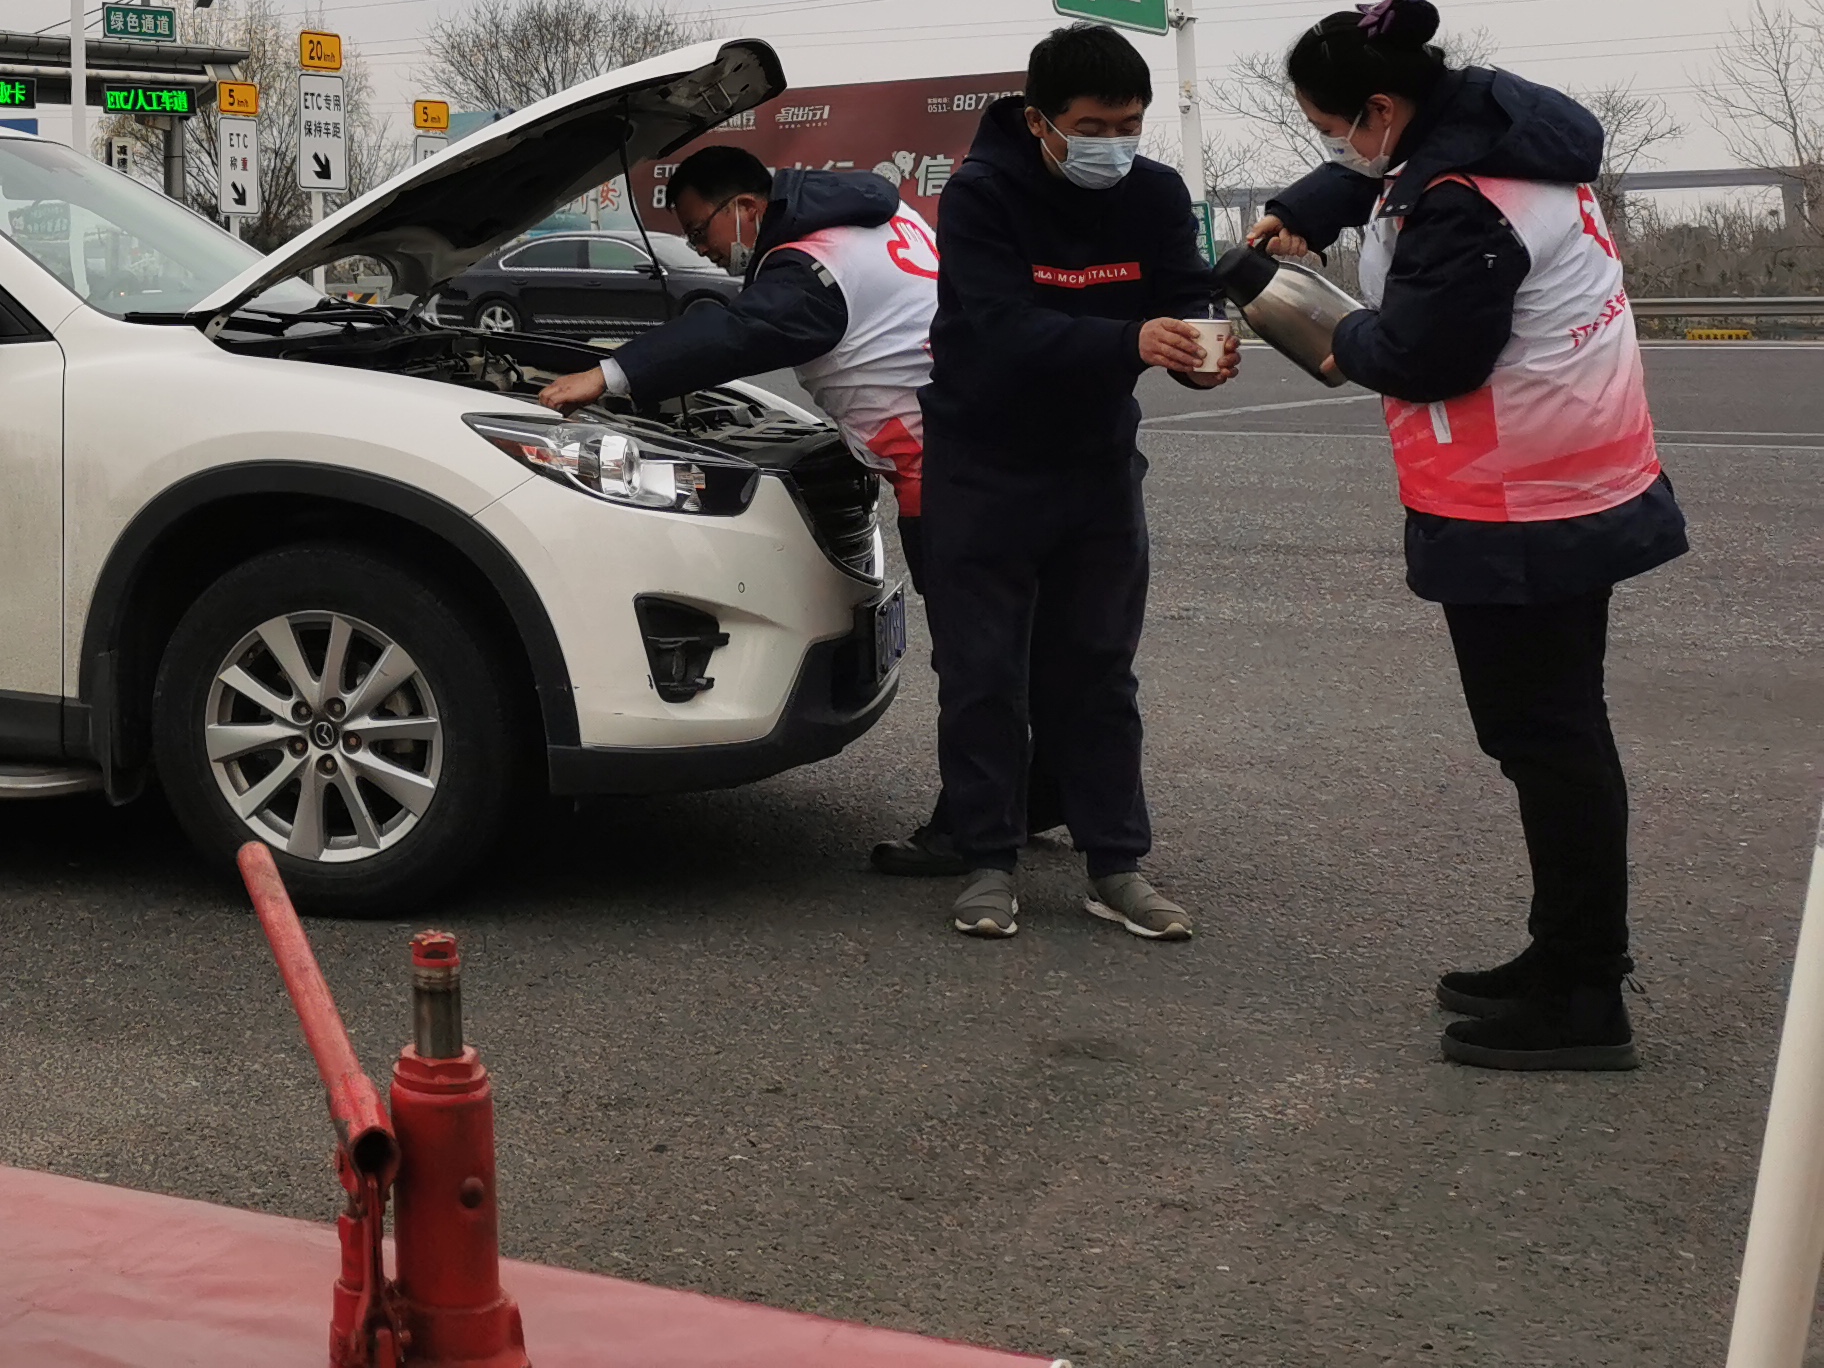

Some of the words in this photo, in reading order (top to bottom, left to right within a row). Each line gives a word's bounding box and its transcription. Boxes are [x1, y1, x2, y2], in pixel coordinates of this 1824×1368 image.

[110, 11, 171, 35] 绿色通道
[106, 89, 188, 112] ETC/人工车道
[303, 120, 342, 140] 保持车距
[229, 133, 249, 149] ETC
[230, 155, 249, 172] 称重
[1088, 267, 1128, 280] ITALIA
